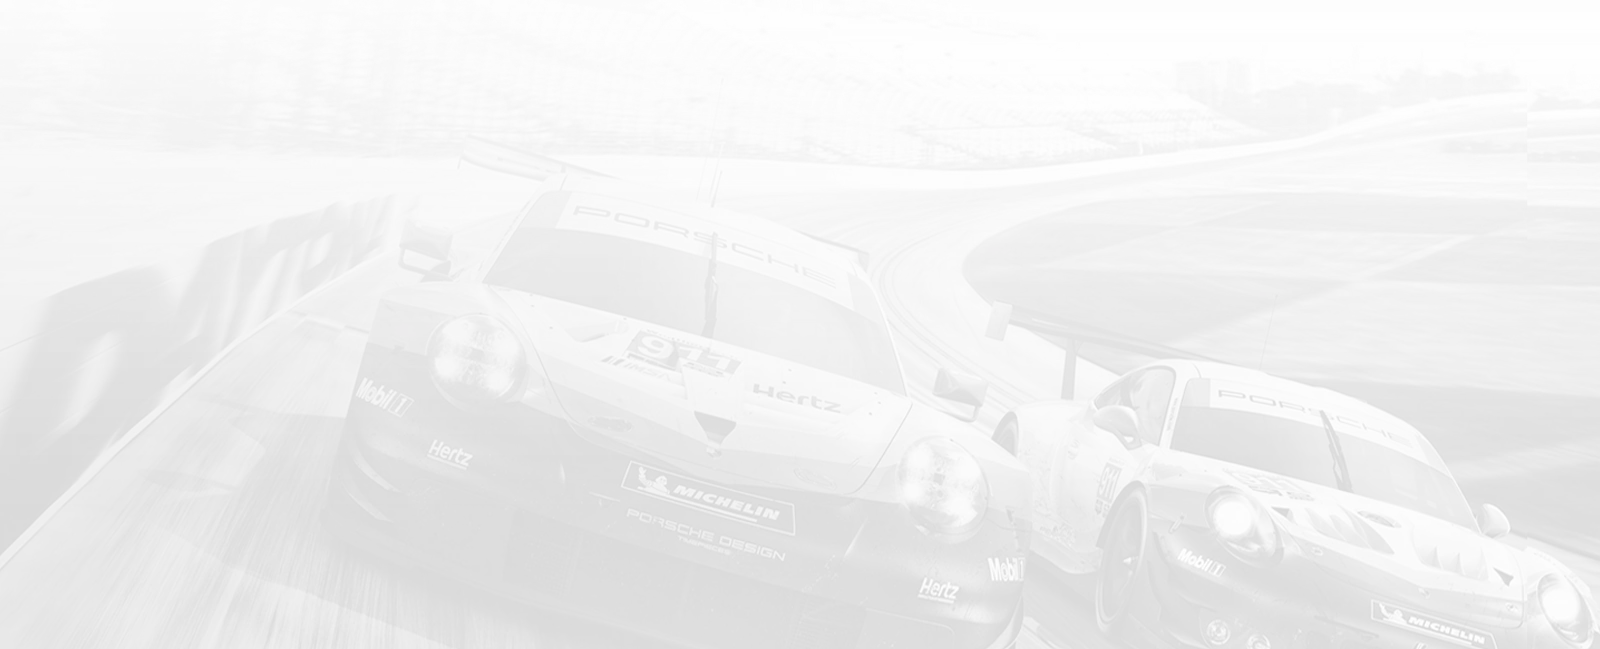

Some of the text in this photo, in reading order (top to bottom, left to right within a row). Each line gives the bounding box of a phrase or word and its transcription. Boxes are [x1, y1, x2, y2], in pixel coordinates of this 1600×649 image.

[573, 205, 836, 289] PORSCHE
[637, 335, 735, 371] 911
[355, 377, 397, 410] Mobil
[753, 383, 842, 413] Hertz
[427, 439, 473, 469] Hertz
[1099, 466, 1120, 501] 911
[673, 484, 780, 521] MICHELIN
[626, 508, 786, 562] PORSCHE DESIGN
[987, 557, 1018, 582] Mobil
[1177, 547, 1214, 572] Mobil
[917, 577, 960, 604] Hertz
[1408, 616, 1485, 645] MICHELIN
